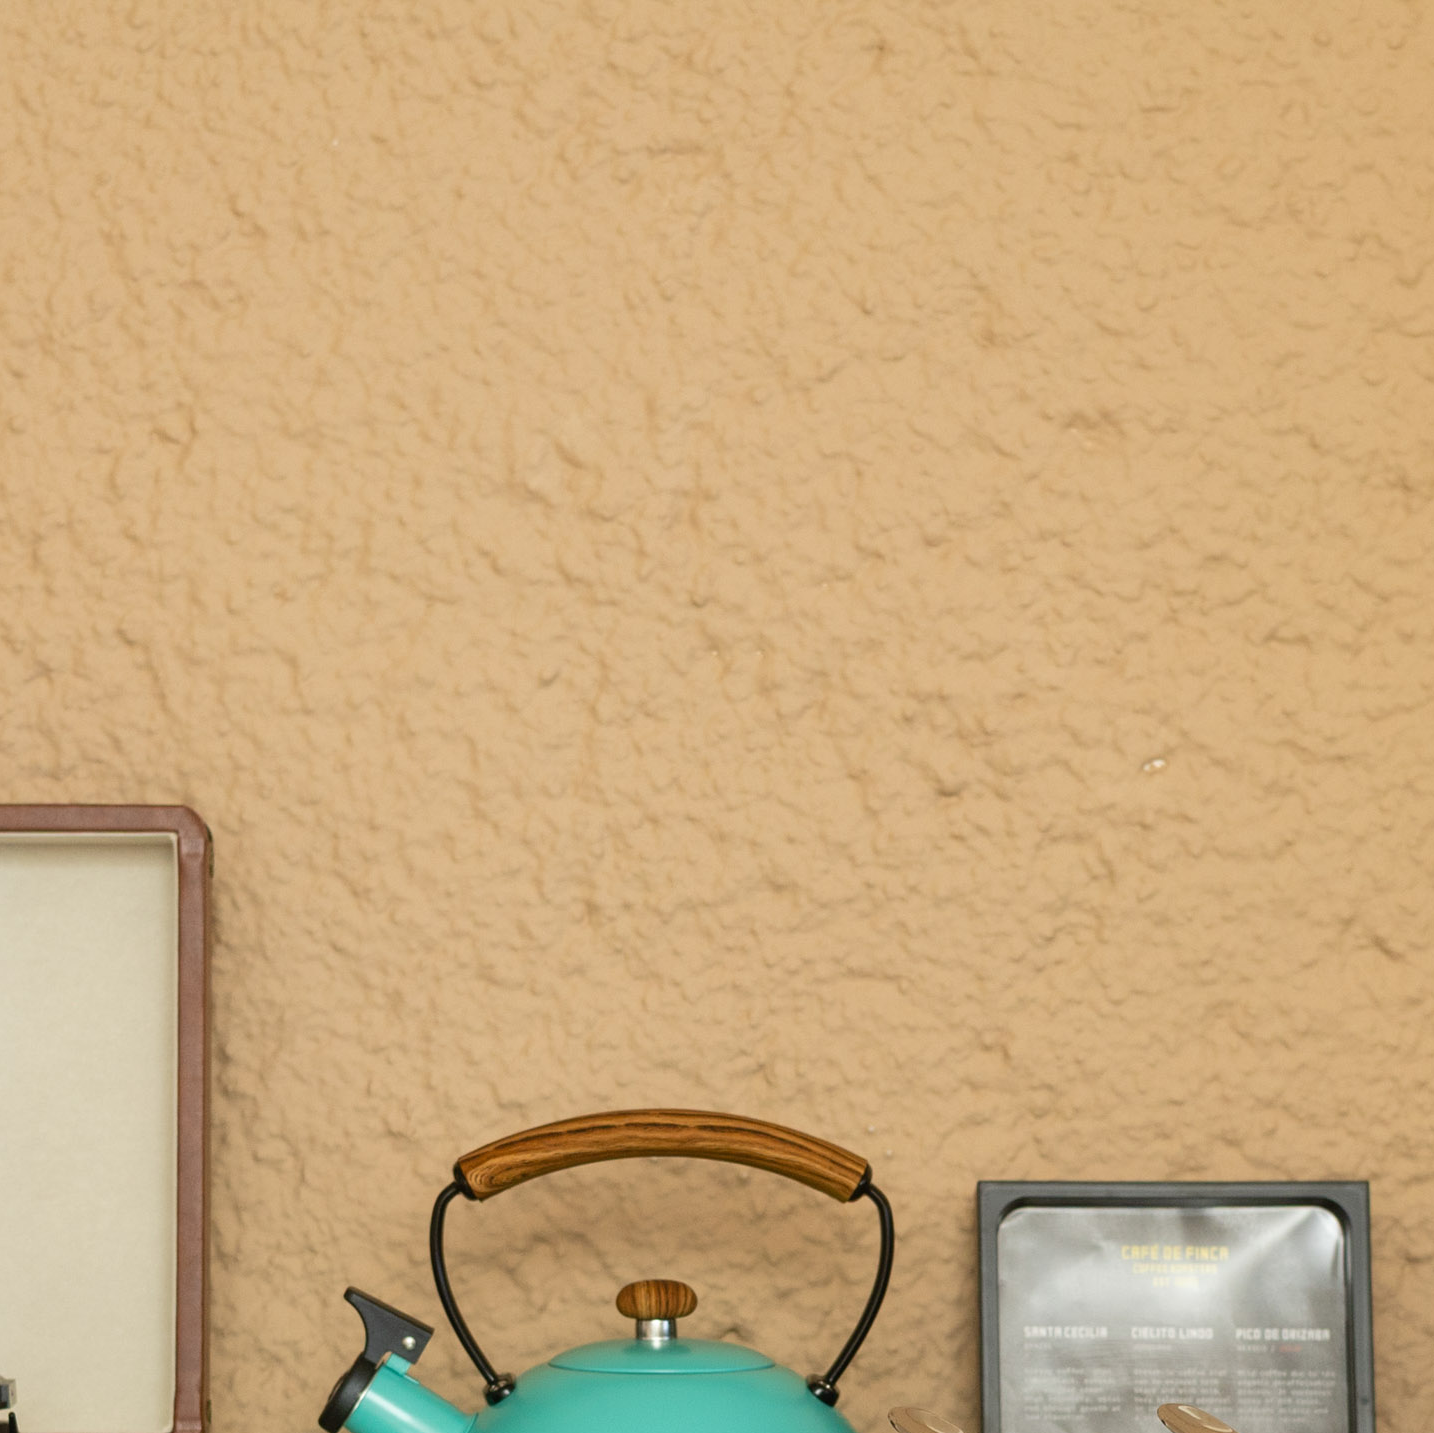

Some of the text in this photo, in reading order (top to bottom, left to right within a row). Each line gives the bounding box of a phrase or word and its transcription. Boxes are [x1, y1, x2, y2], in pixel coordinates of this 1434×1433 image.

[1163, 1245, 1183, 1260] DE
[1185, 1245, 1229, 1261] FINCA
[1023, 1326, 1108, 1339] SANTA CECILIA
[1131, 1327, 1214, 1340] CIELITO LINDO
[1235, 1327, 1331, 1341] PICO DE ORIZABA
